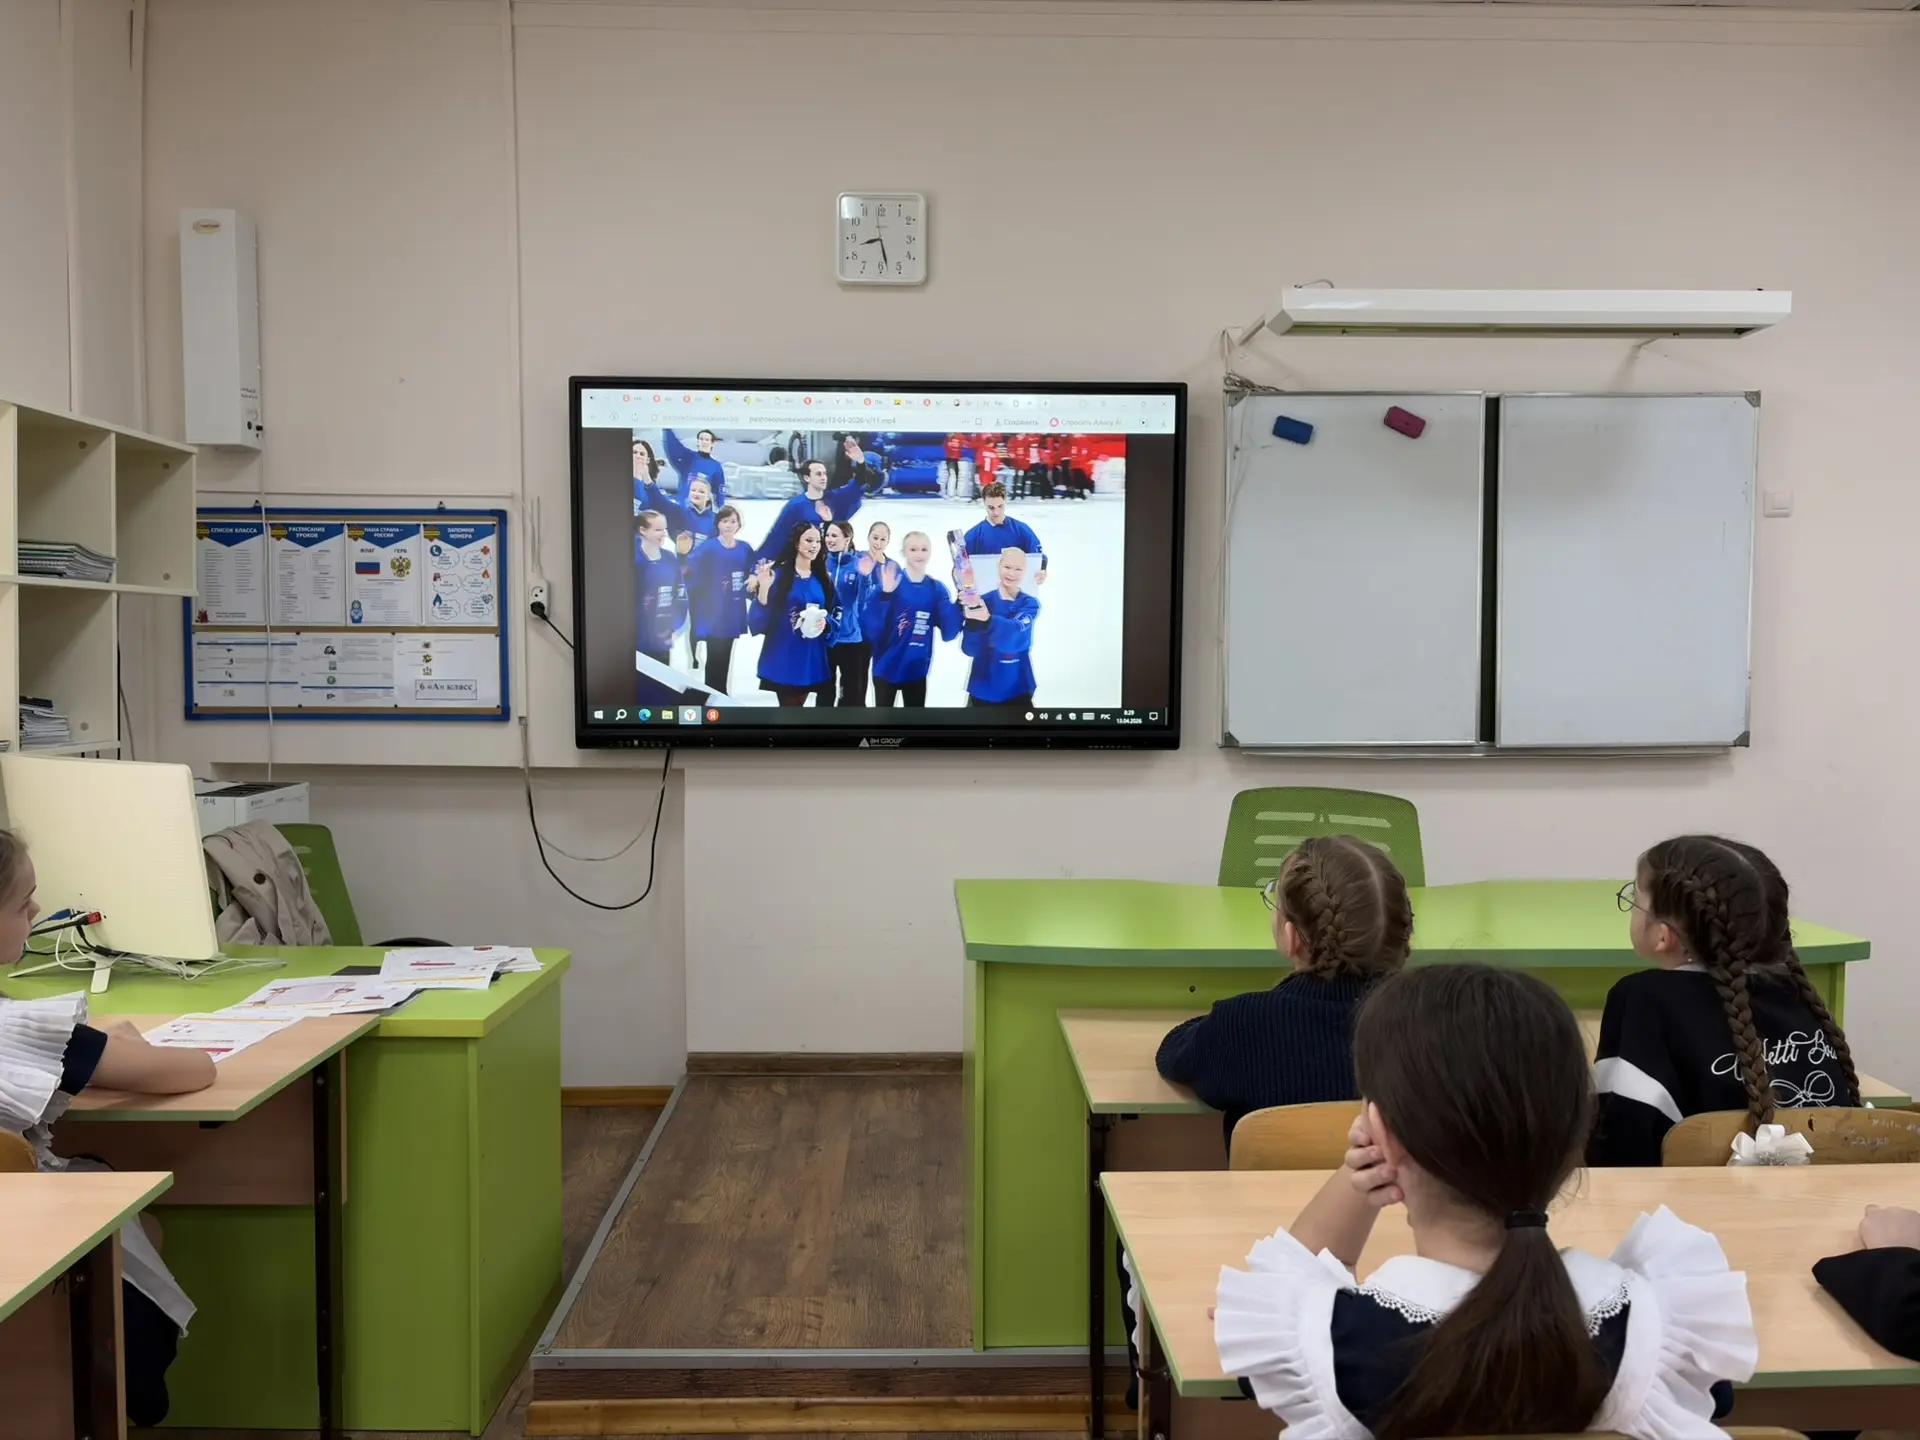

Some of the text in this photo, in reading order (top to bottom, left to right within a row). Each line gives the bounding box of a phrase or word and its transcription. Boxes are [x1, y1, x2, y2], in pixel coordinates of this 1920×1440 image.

[861, 206, 868, 217] 11
[877, 206, 886, 217] 12
[897, 208, 901, 217] 1
[851, 217, 861, 227] 10
[905, 215, 912, 226] 2
[851, 233, 857, 243] 9
[905, 235, 912, 245] 3
[851, 251, 858, 261] 8
[905, 251, 912, 260] 4
[861, 260, 867, 270] 7
[877, 262, 884, 271] 6
[895, 261, 902, 271] 5
[419, 683, 473, 691] 6 «А» класс
